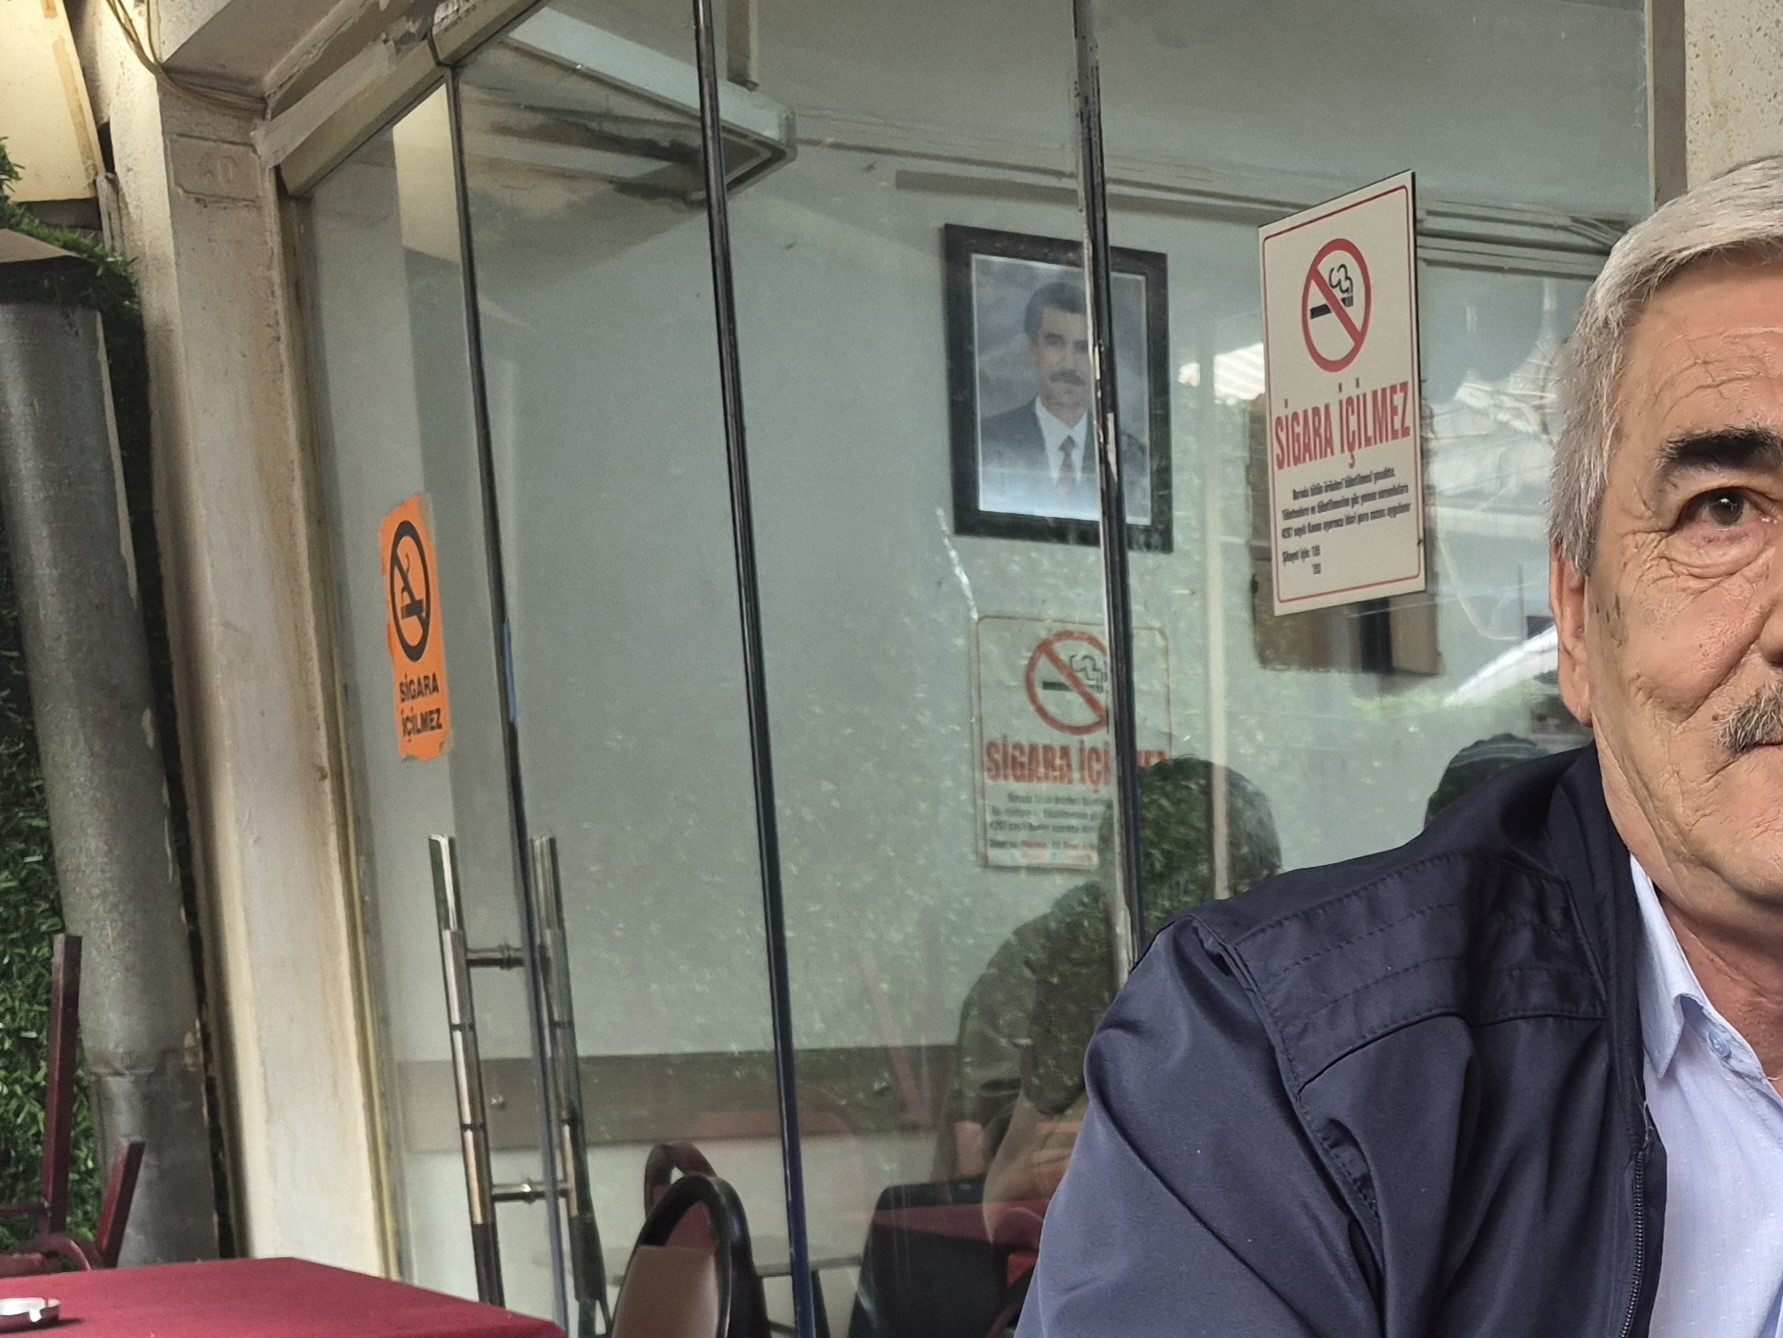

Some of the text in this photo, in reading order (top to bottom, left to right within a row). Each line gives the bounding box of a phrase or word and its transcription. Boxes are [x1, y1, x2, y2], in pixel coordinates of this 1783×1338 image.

[1274, 377, 1411, 470] SİGARA İÇİLMEZ
[399, 672, 439, 702] SİGARA
[401, 706, 442, 742] İÇİLMEZ
[986, 735, 1073, 785] SİGARA
